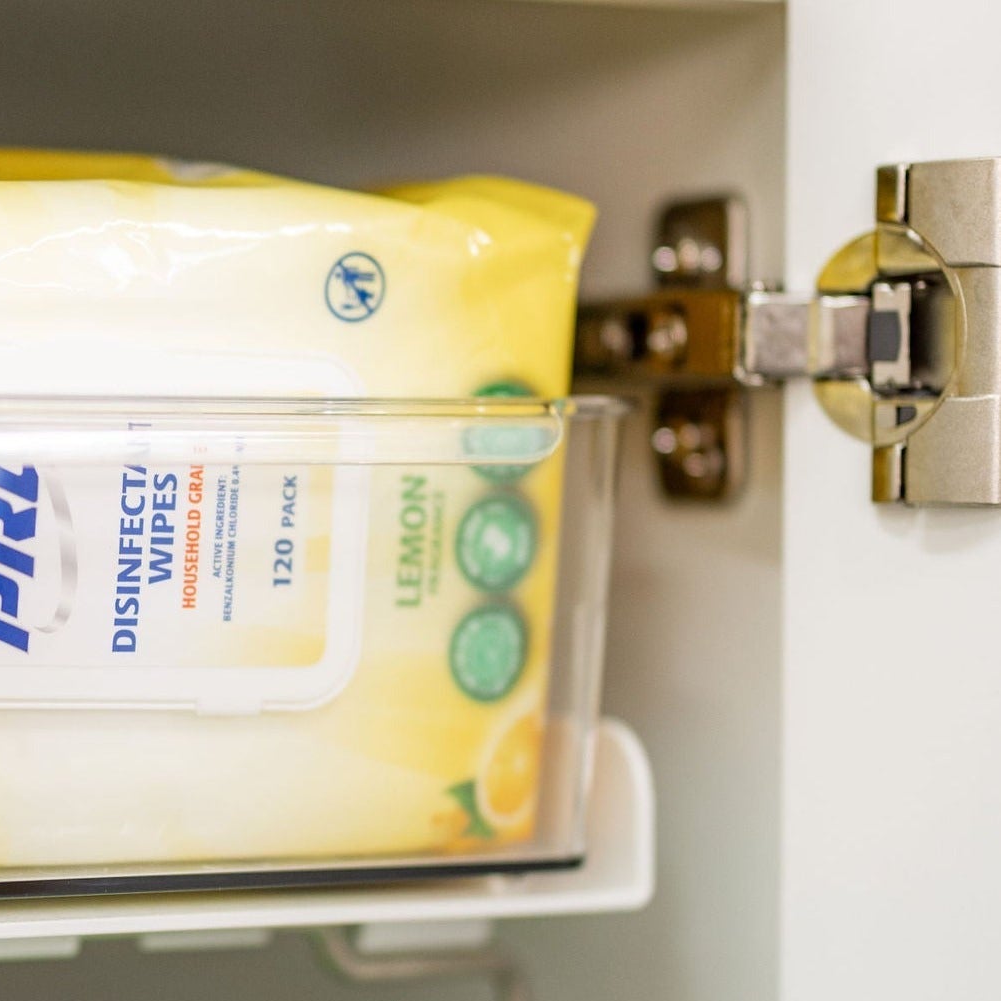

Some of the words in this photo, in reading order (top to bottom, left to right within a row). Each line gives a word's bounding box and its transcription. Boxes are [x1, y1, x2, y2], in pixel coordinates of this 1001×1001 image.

[148, 473, 178, 585] WIPES
[215, 475, 227, 540] INGREDIENT:
[227, 488, 240, 538] CHLORIDE
[280, 473, 298, 528] PACK
[182, 509, 201, 609] HOUSEHOLD
[212, 543, 223, 578] ACTIVE
[272, 539, 295, 588] 120
[395, 474, 427, 609] LEMON
[223, 540, 236, 621] BENZALKONIUM
